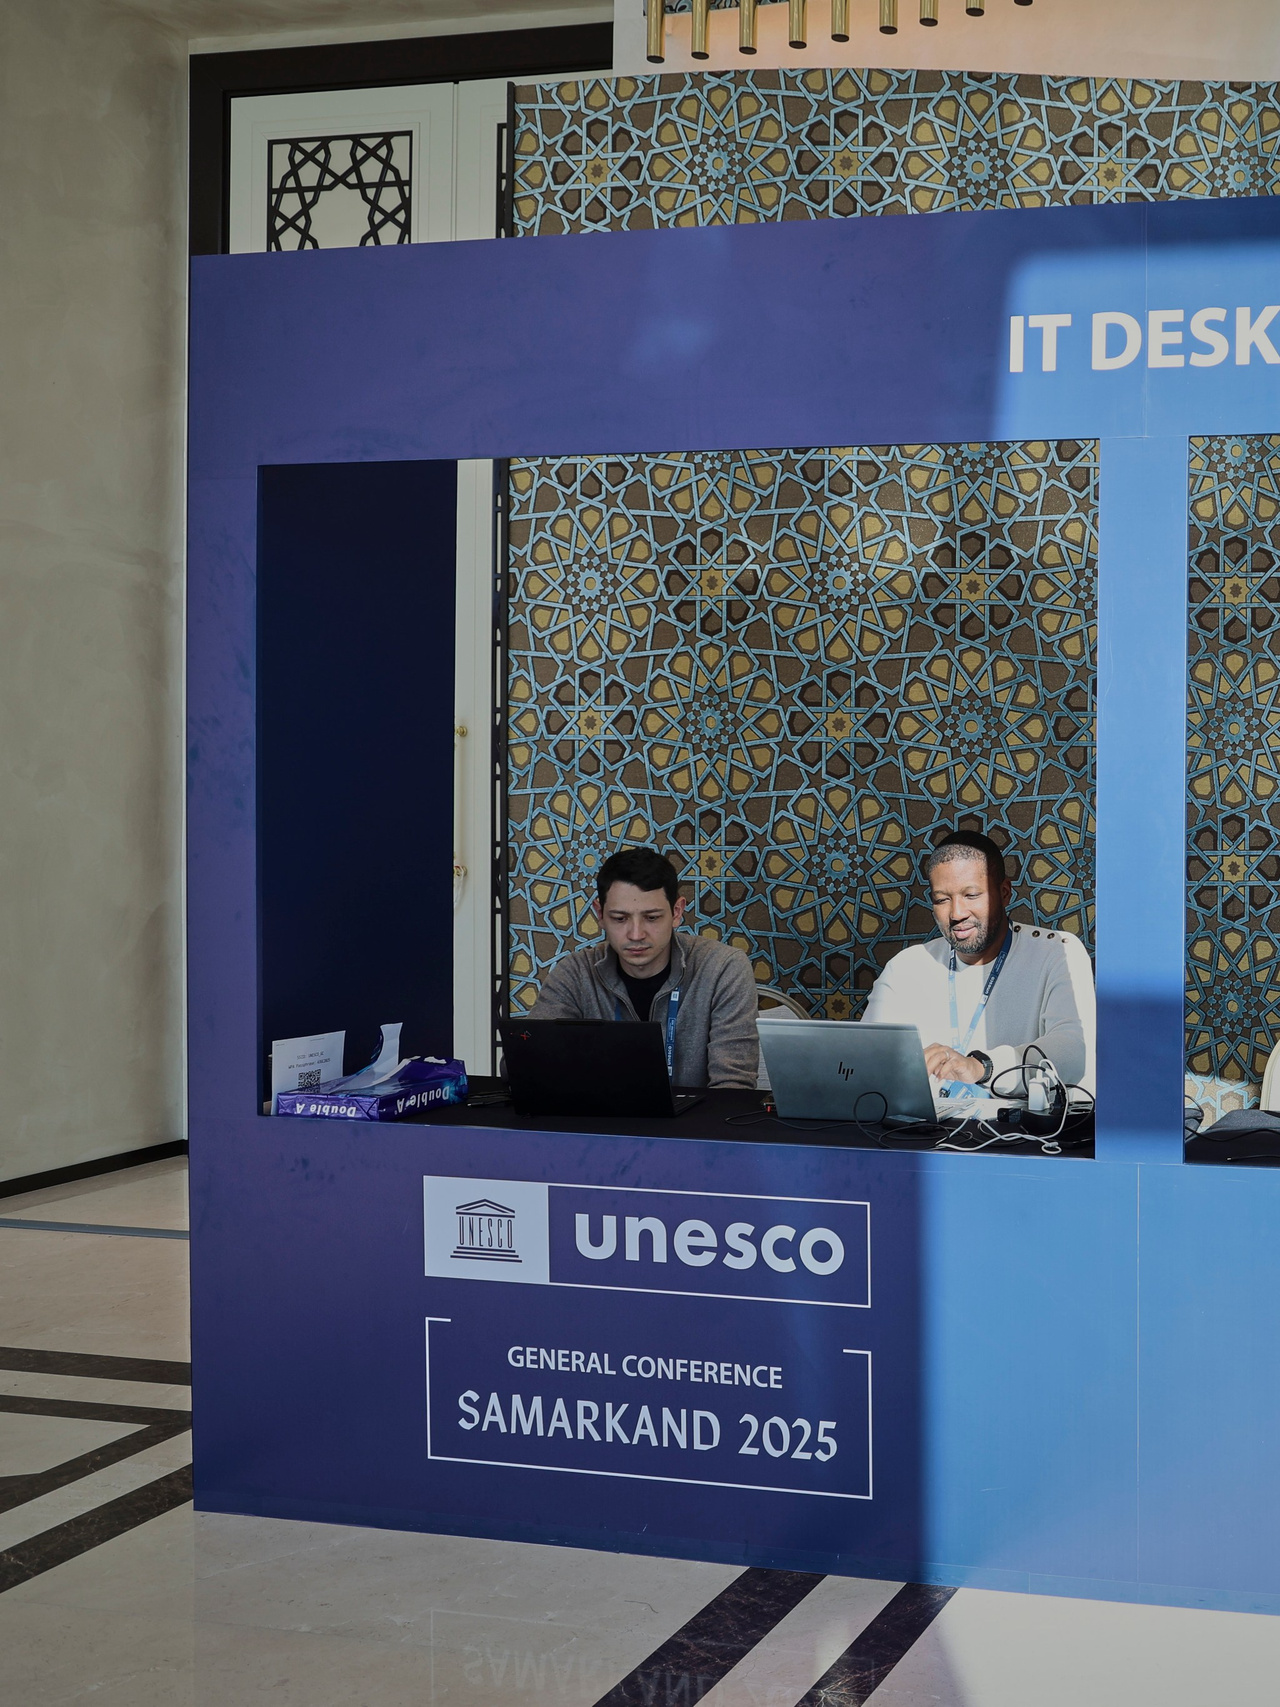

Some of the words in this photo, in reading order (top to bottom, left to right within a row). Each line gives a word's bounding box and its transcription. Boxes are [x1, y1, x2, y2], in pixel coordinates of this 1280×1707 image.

[1009, 313, 1072, 373] IT
[309, 1103, 357, 1117] Double
[396, 1099, 405, 1112] A
[409, 1085, 450, 1108] Double
[459, 1215, 513, 1249] UNESCO
[574, 1212, 845, 1276] unesco
[507, 1345, 616, 1376] GENERAL
[621, 1354, 783, 1389] CONFERENCE
[457, 1389, 721, 1451] SAMARKAND
[738, 1412, 838, 1463] 2025
